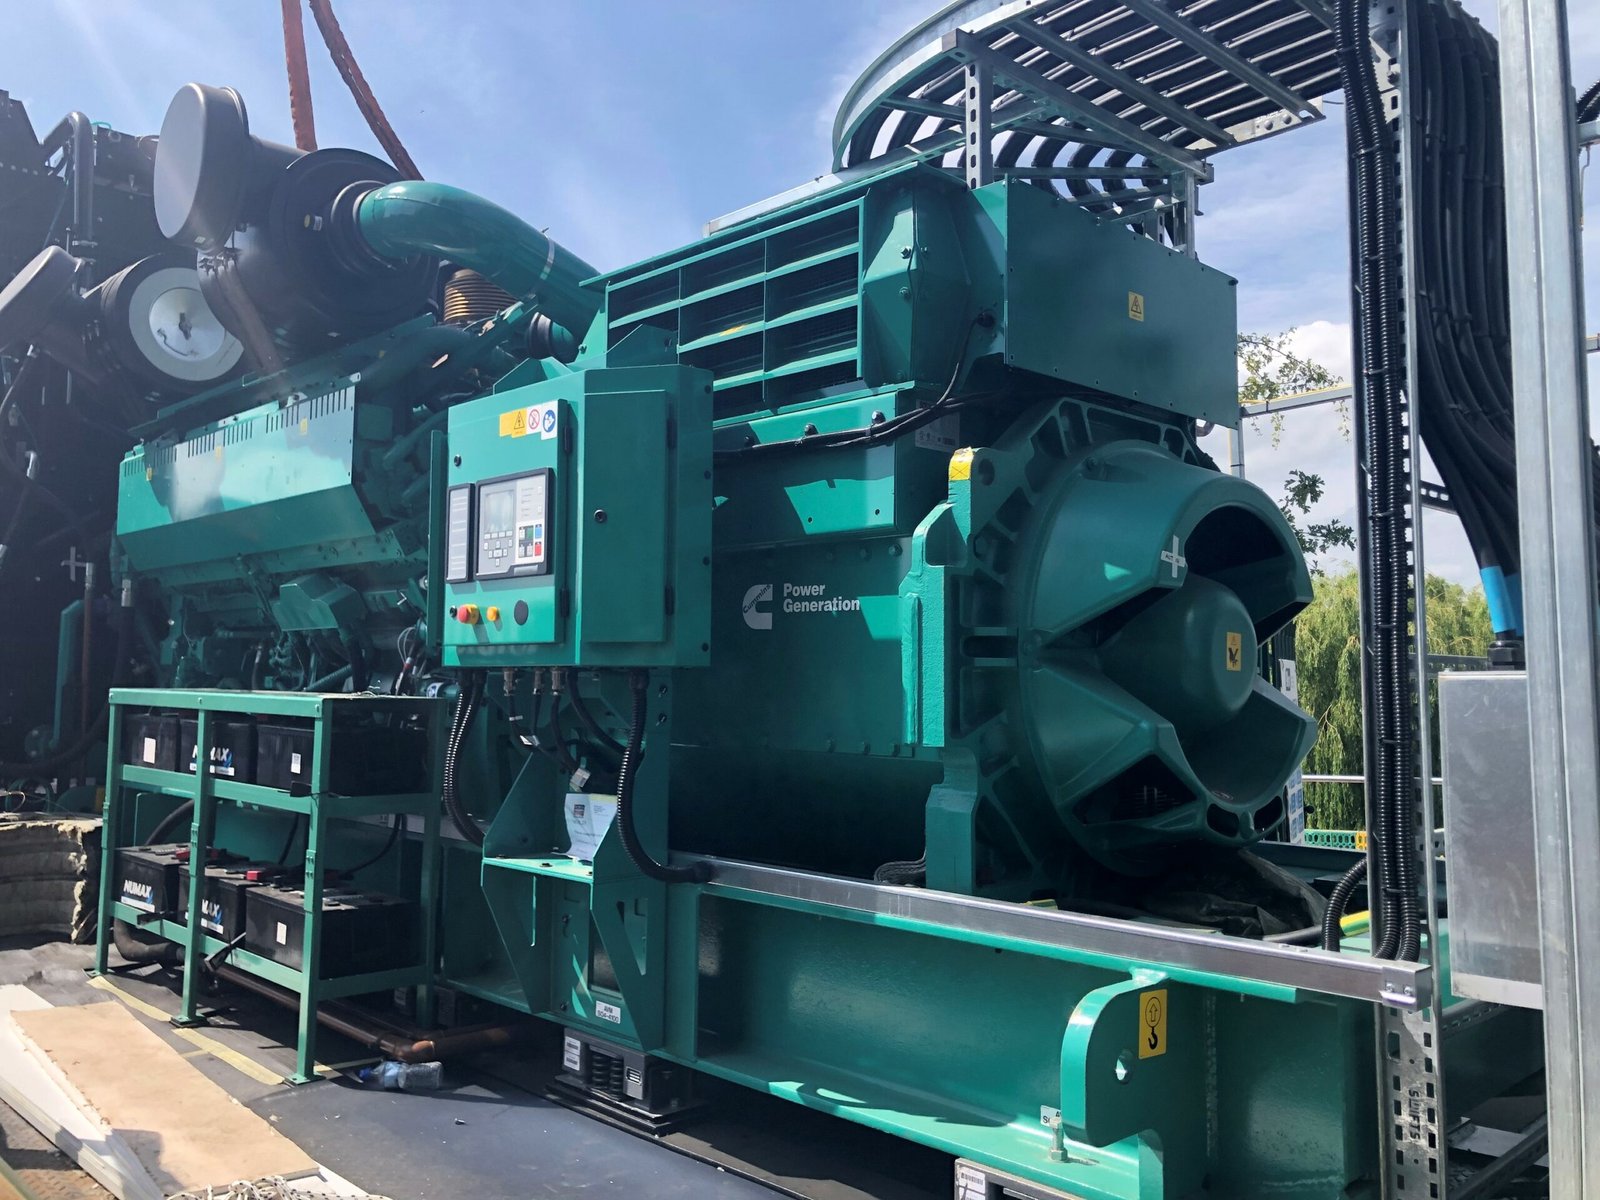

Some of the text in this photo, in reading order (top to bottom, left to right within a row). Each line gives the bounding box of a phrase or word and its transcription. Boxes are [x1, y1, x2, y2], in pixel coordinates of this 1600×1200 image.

[743, 584, 772, 613] Cummins
[783, 583, 825, 597] Power
[783, 596, 860, 613] Generation
[123, 879, 152, 898] NUMAX
